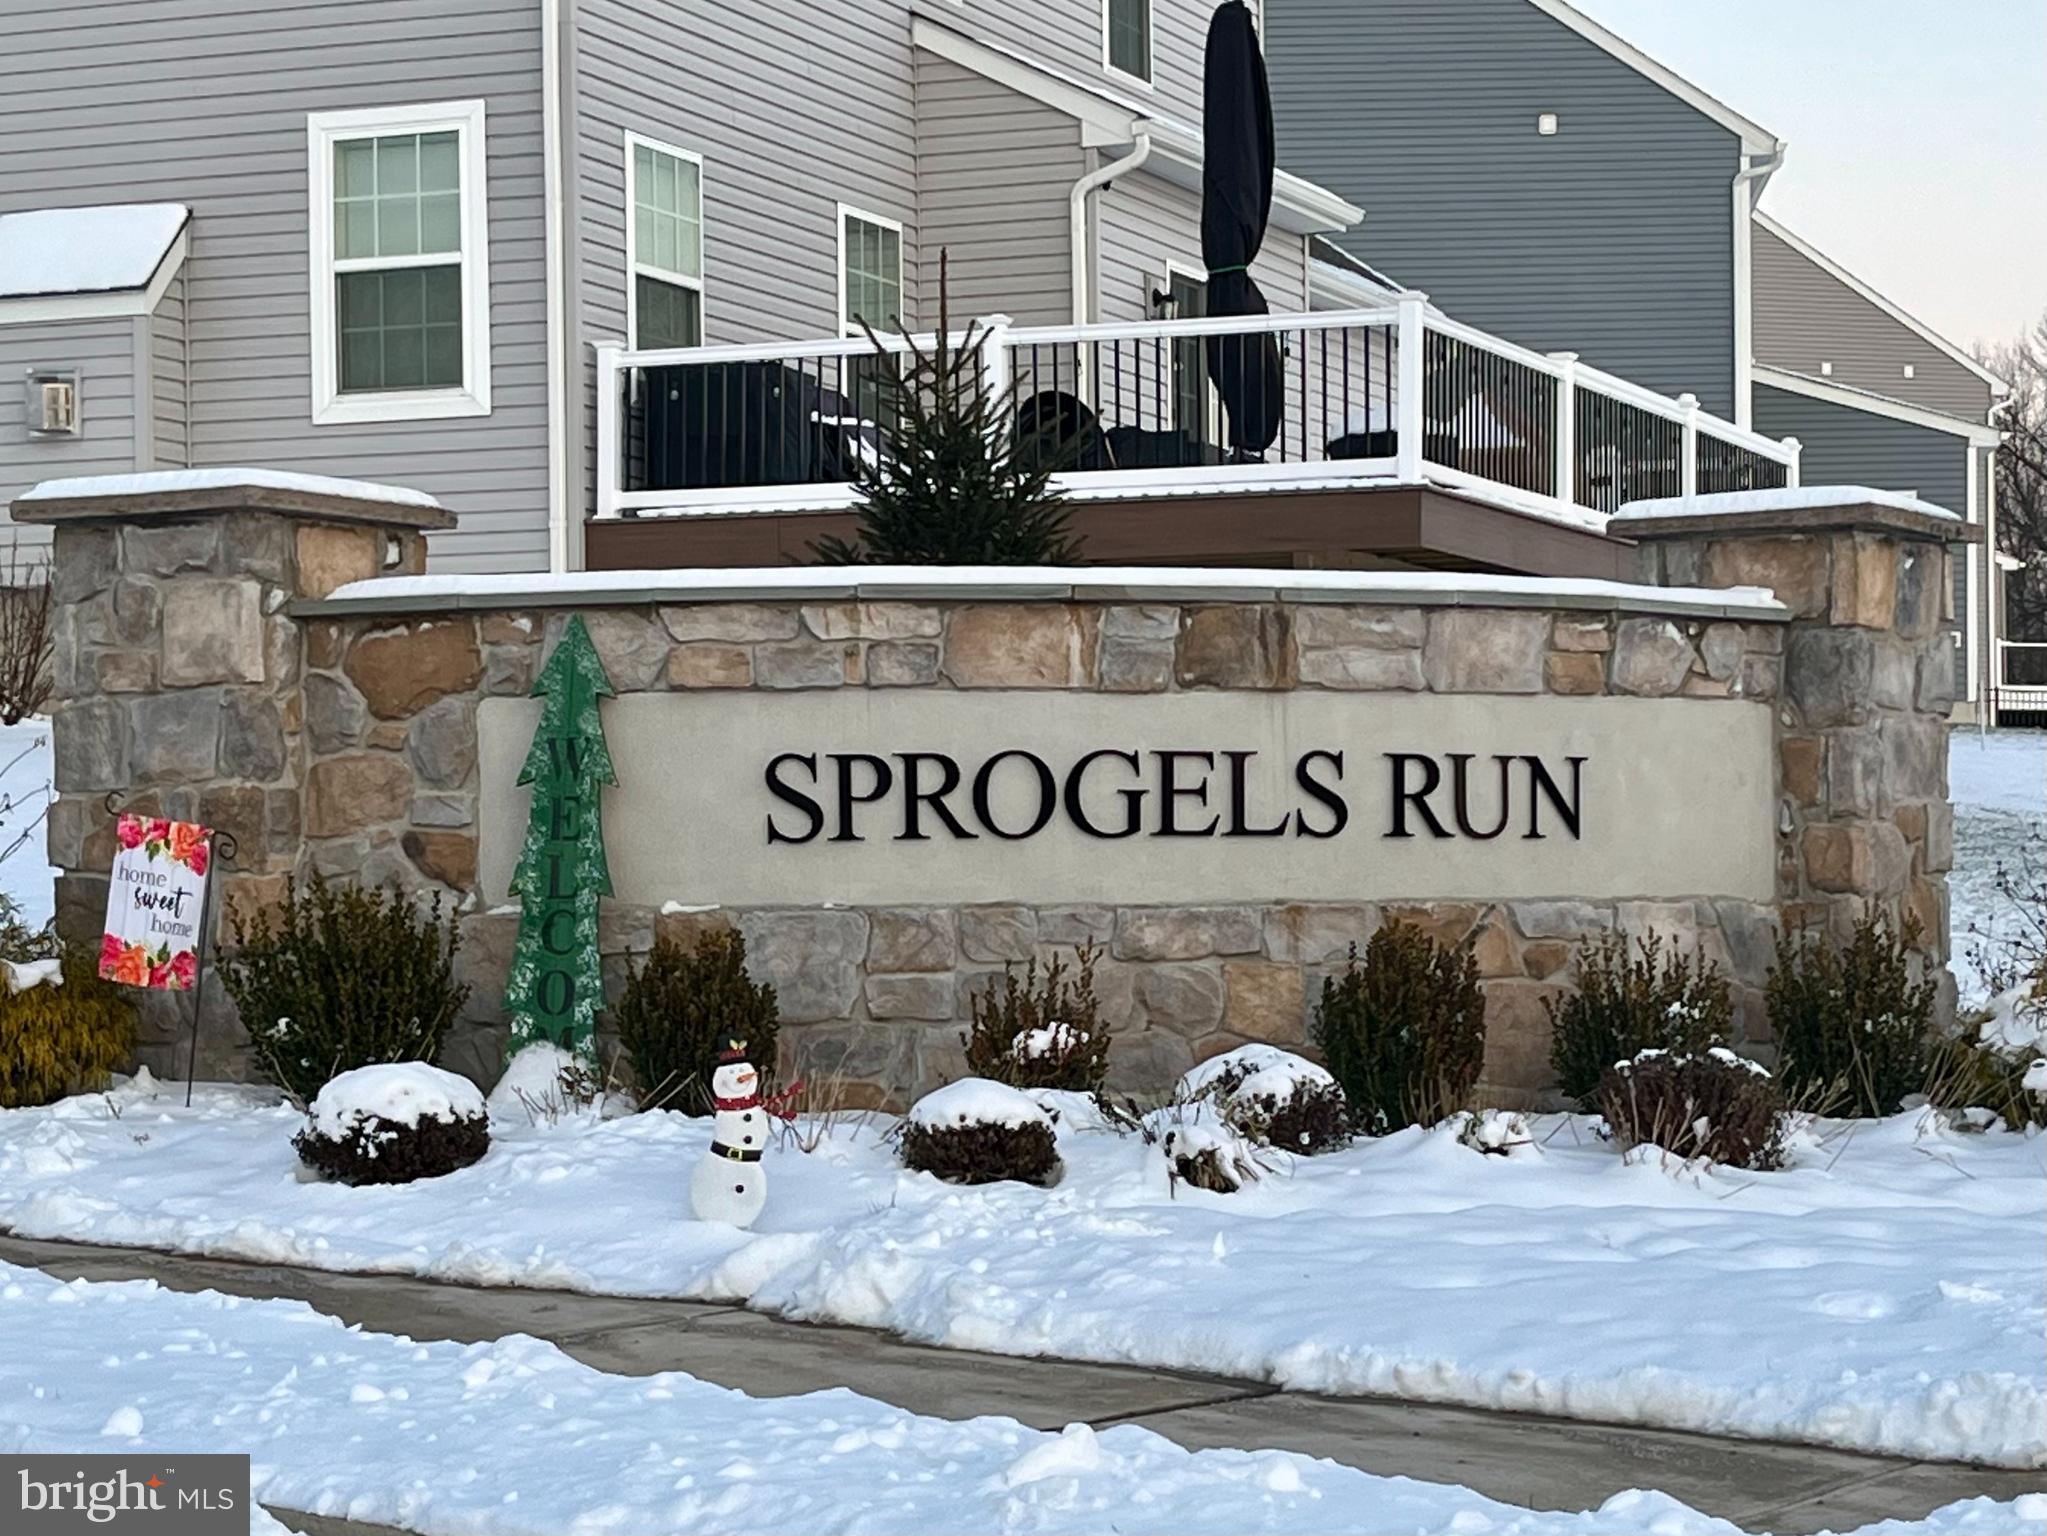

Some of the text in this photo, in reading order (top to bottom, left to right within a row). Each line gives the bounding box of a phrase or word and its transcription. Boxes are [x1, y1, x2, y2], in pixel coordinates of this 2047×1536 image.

[763, 749, 1588, 846] SPROGELS RUN
[117, 860, 168, 887] home
[134, 886, 193, 919] sweet
[149, 913, 193, 937] home
